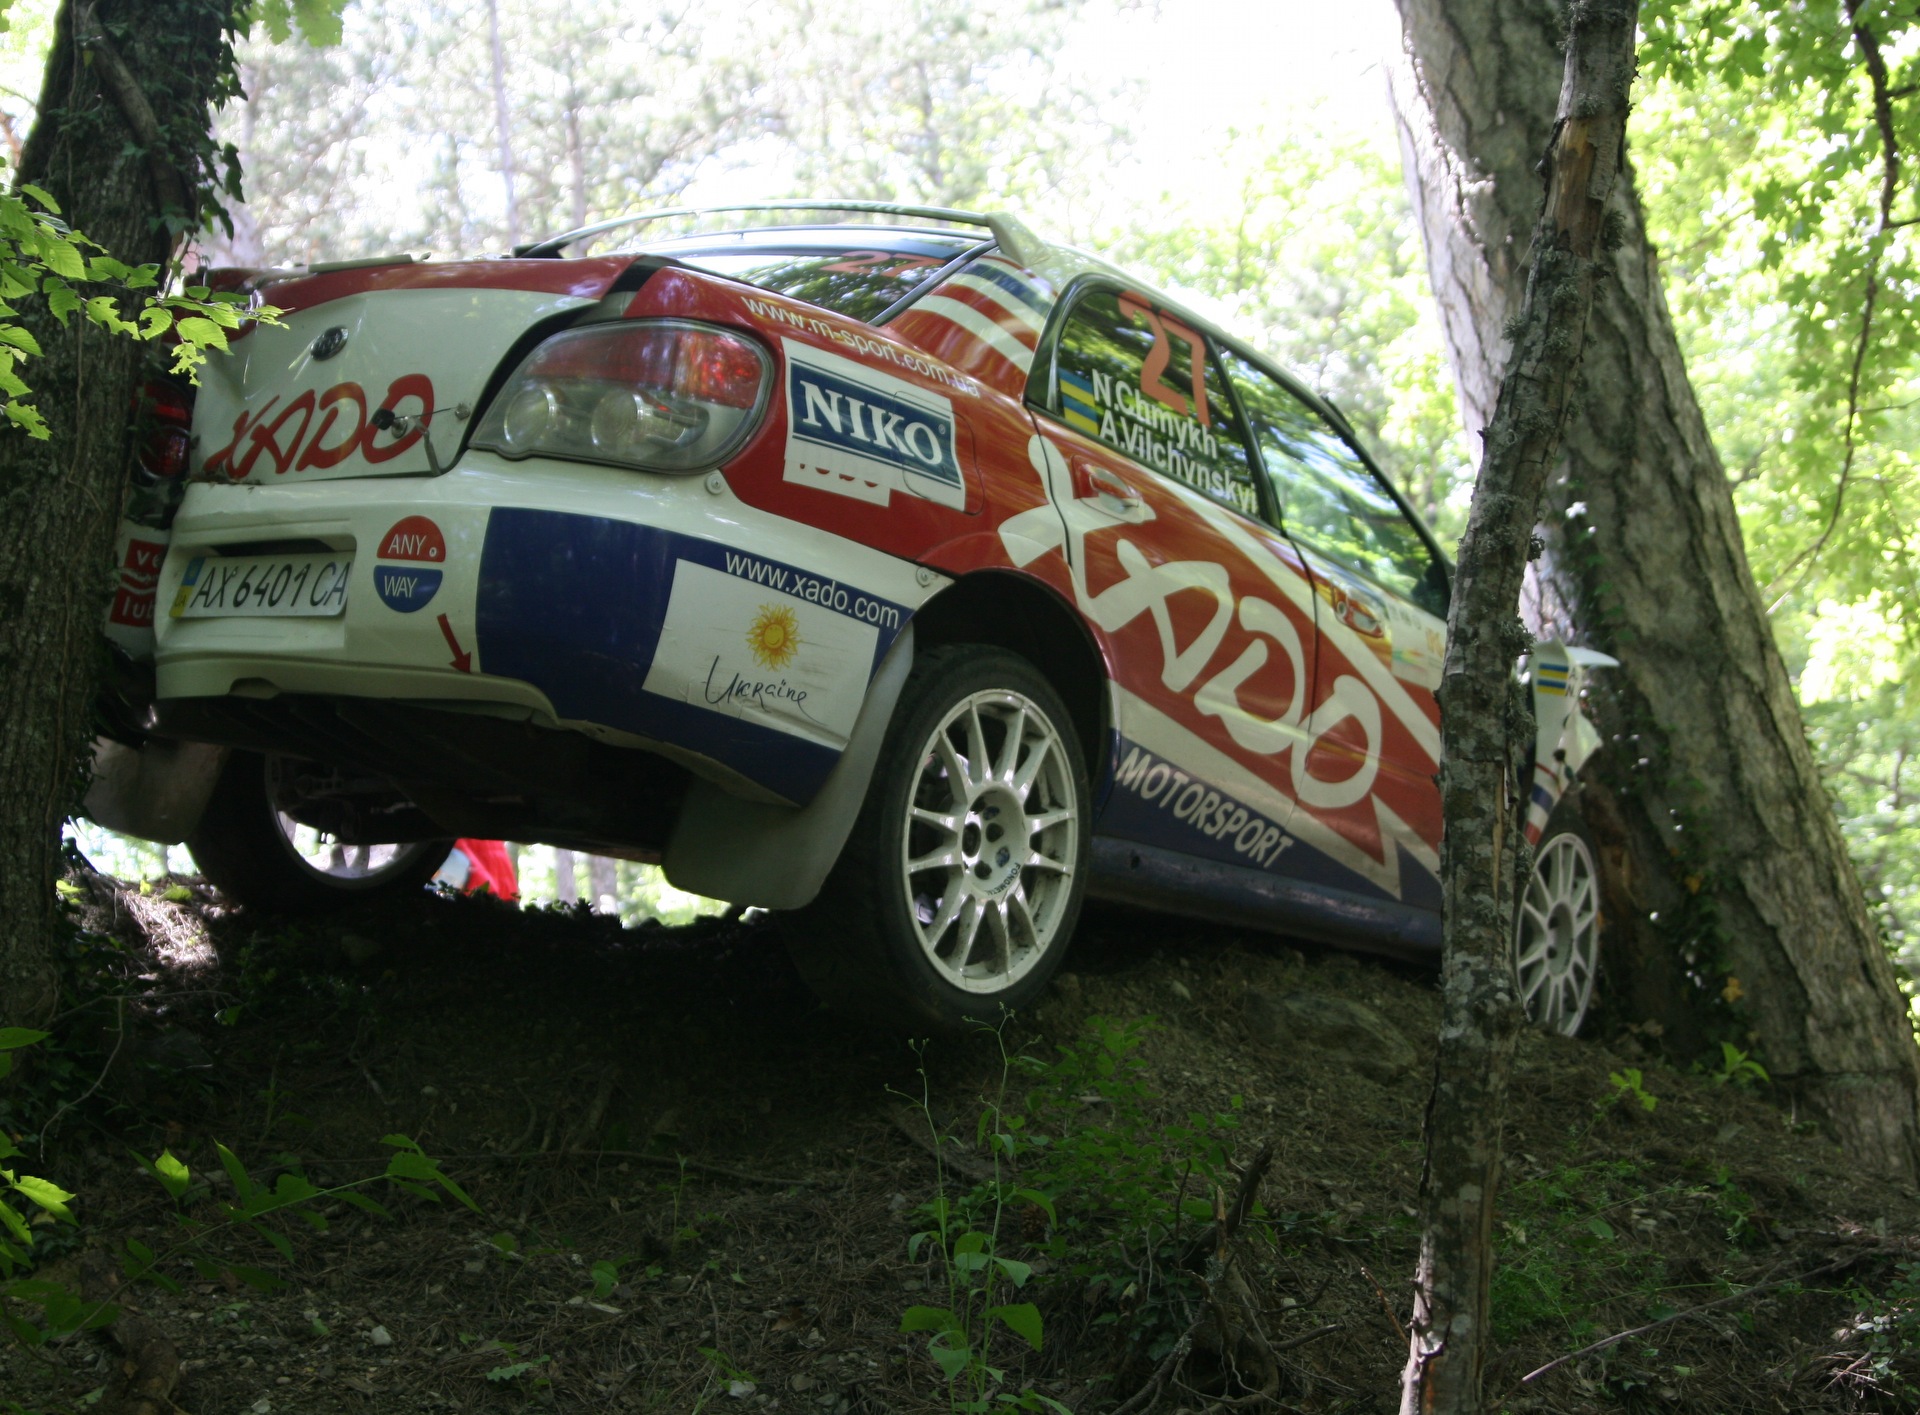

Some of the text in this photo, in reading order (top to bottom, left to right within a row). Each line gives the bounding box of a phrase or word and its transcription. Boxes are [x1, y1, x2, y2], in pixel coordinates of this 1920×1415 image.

[820, 249, 947, 278] 27
[740, 296, 981, 399] www.m-sport.com.ua
[1117, 289, 1212, 429] 27
[202, 372, 435, 479] XADO
[800, 379, 943, 465] NIKO
[384, 575, 418, 598] WAY
[387, 533, 427, 556] ANY
[725, 551, 900, 630] www.xado.com
[997, 433, 1383, 809] XADO
[1114, 746, 1294, 869] MOTORSPORT
